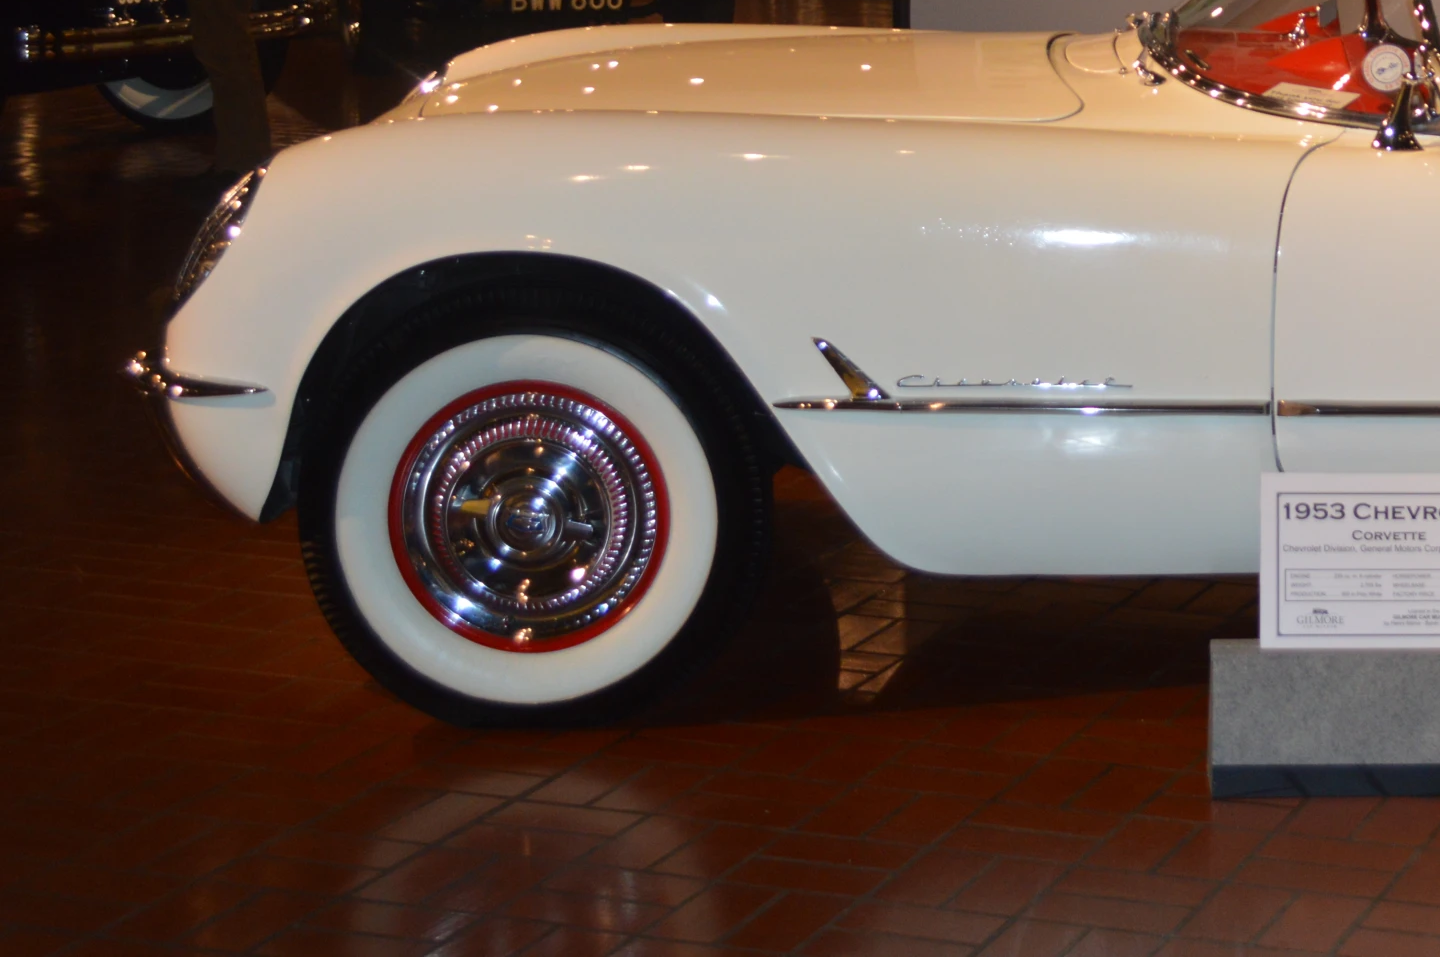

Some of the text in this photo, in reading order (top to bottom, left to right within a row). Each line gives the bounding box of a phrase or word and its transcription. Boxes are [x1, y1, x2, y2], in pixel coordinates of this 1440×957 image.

[1283, 502, 1346, 520] 1953
[1351, 529, 1427, 541] CORVETTE
[1282, 544, 1322, 553] Chevrolet
[1359, 544, 1392, 553] General
[1393, 544, 1422, 553] Motors
[1296, 614, 1344, 624] GILMORE
